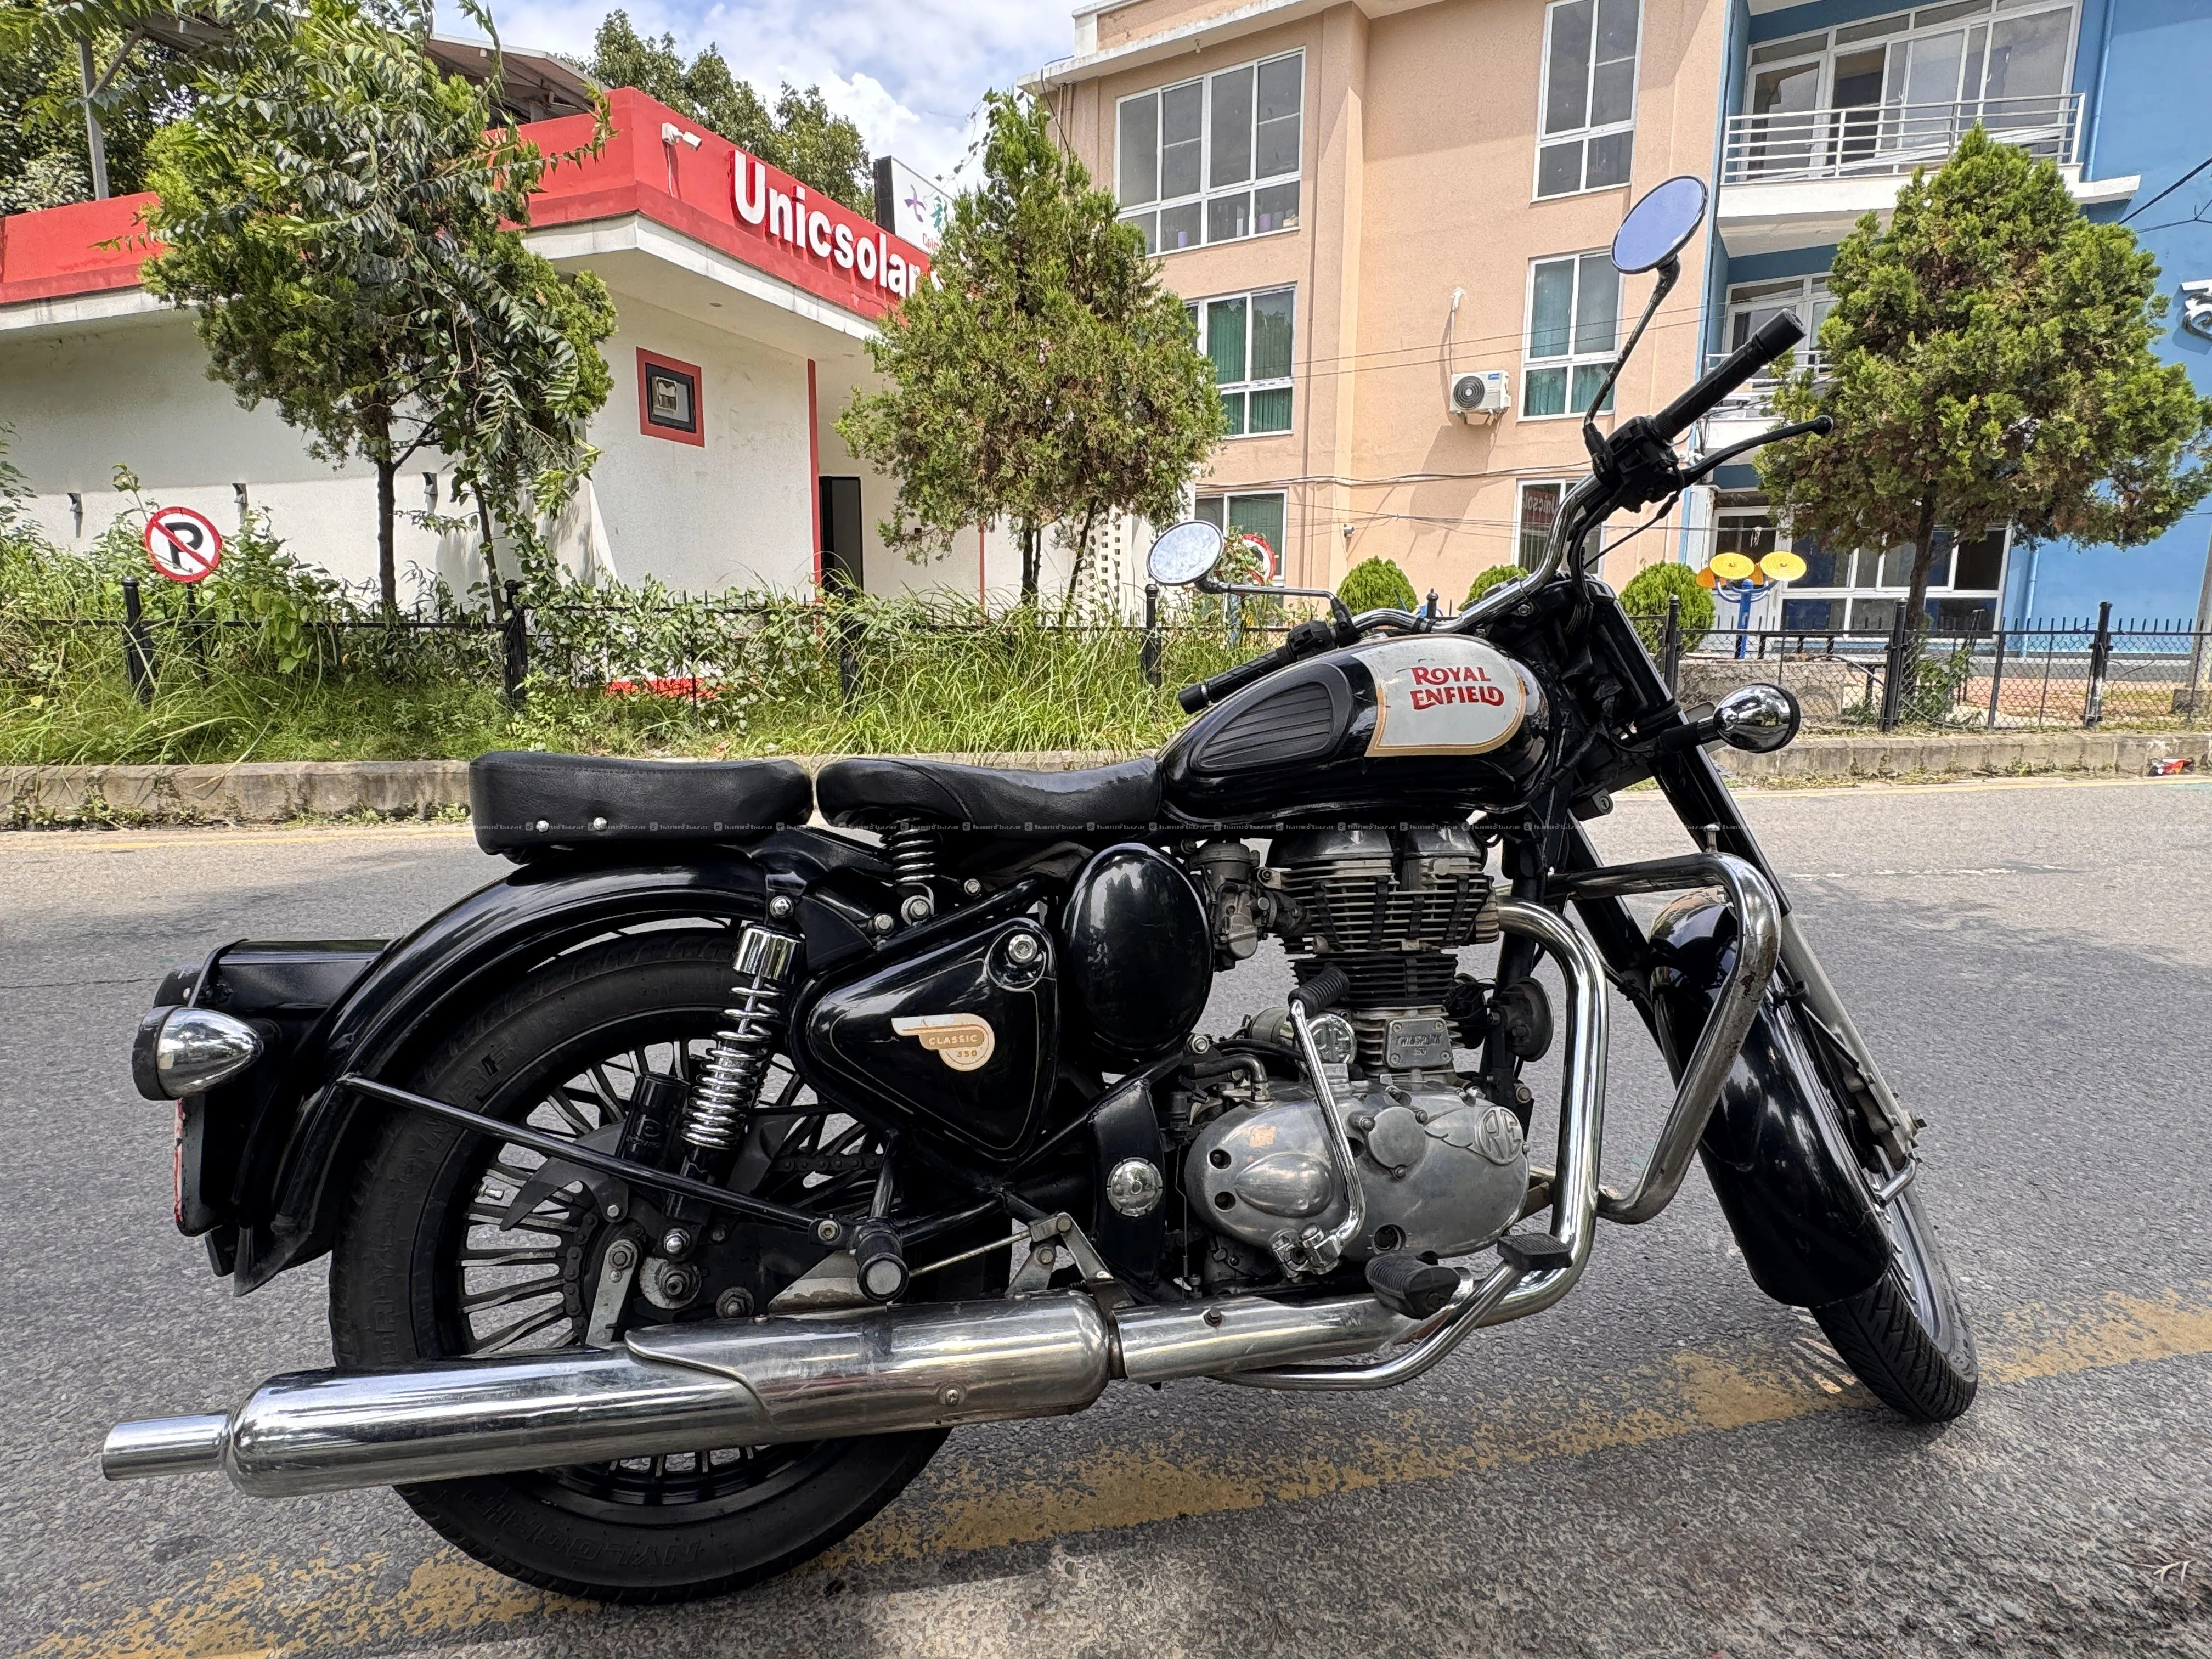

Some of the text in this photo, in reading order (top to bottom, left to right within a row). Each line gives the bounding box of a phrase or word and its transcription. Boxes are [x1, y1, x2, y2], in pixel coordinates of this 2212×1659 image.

[1411, 667, 1491, 686] ROYAL
[1410, 686, 1504, 710] ENFIELD
[928, 1034, 978, 1045] CLASSIC
